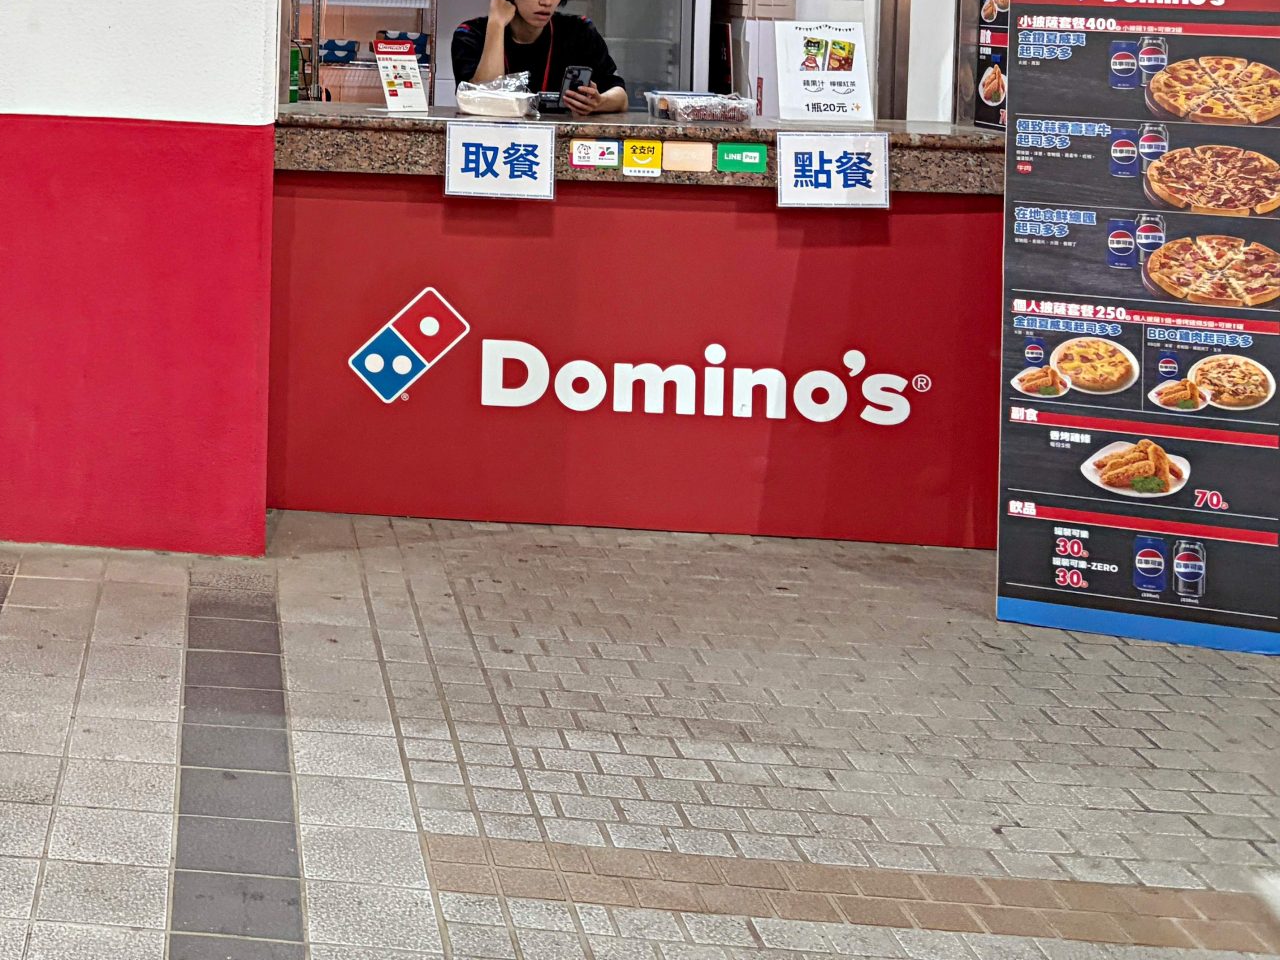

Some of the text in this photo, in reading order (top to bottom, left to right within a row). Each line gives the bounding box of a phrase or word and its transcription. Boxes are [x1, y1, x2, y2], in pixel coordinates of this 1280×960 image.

[1017, 45, 1072, 60] 起司多多
[804, 102, 848, 113] 1瓶20元
[1016, 133, 1071, 149] 起司多多
[630, 145, 655, 155] 全支付
[724, 152, 759, 162] LINE Pay
[460, 141, 540, 180] 取餐
[793, 150, 874, 190] 點餐
[1014, 221, 1069, 237] 起司多多
